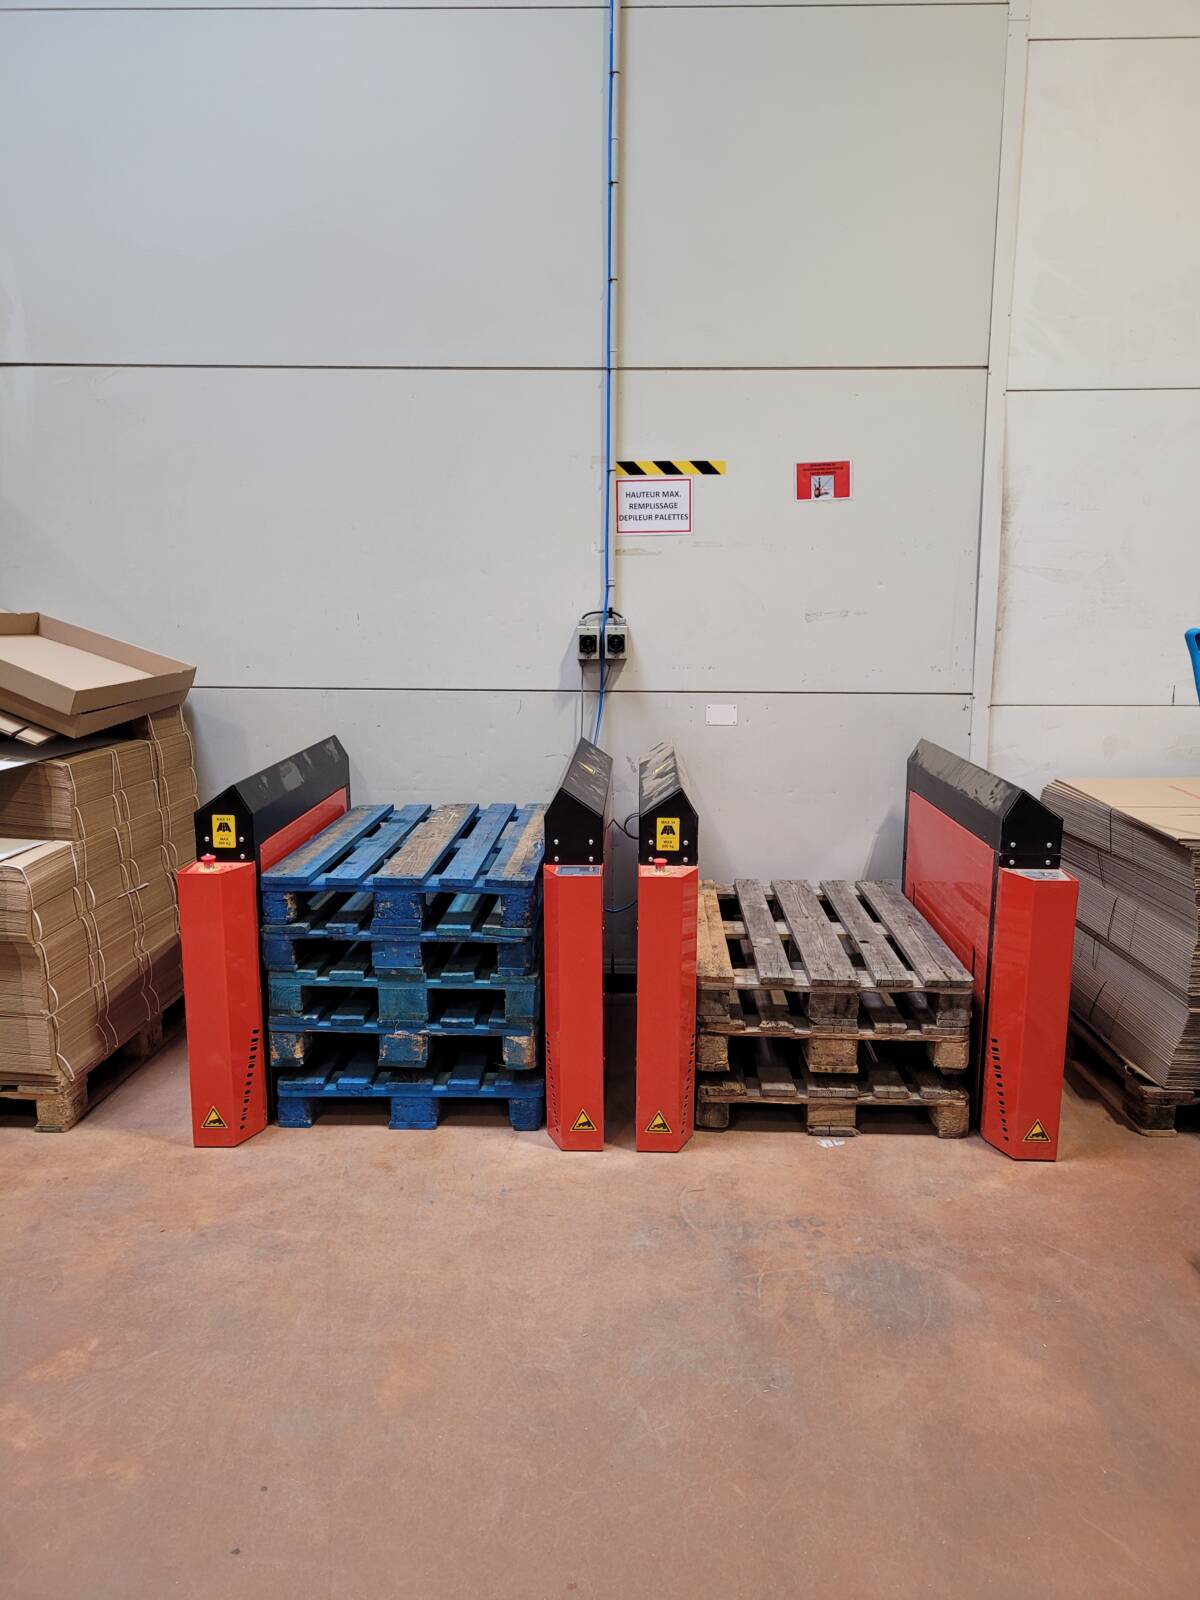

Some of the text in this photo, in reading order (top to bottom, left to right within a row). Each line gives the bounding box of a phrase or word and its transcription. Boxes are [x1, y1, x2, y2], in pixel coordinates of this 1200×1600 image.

[662, 490, 682, 498] MAX.
[618, 513, 689, 522] DEPILEUR PALETTES
